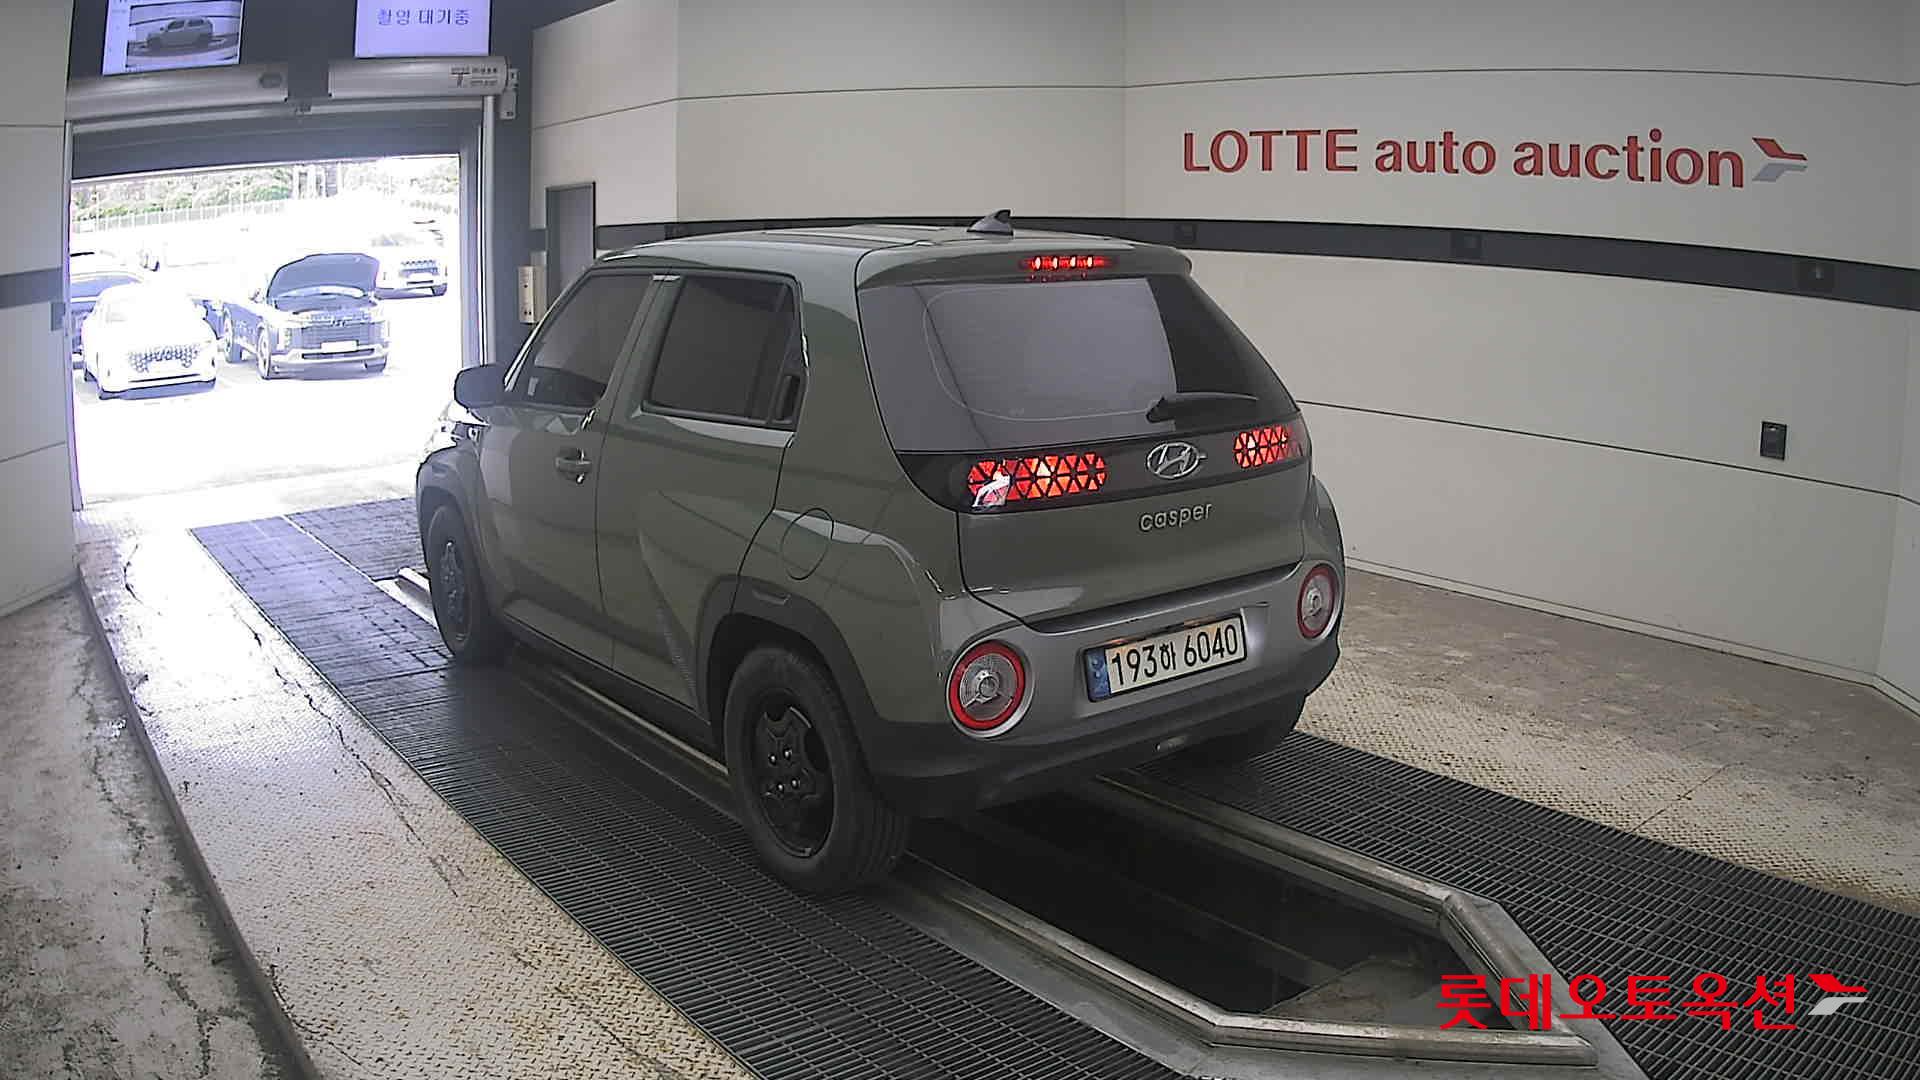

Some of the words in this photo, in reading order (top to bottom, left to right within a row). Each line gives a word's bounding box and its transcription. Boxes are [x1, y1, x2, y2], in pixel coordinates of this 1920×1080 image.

[418, 8, 471, 26] 대기중
[1183, 128, 1359, 173] LOTTE
[1374, 130, 1497, 175] auto
[1512, 128, 1744, 189] auction
[1140, 503, 1213, 532] casper
[1111, 641, 1177, 685] 193하
[1183, 624, 1238, 667] 6040
